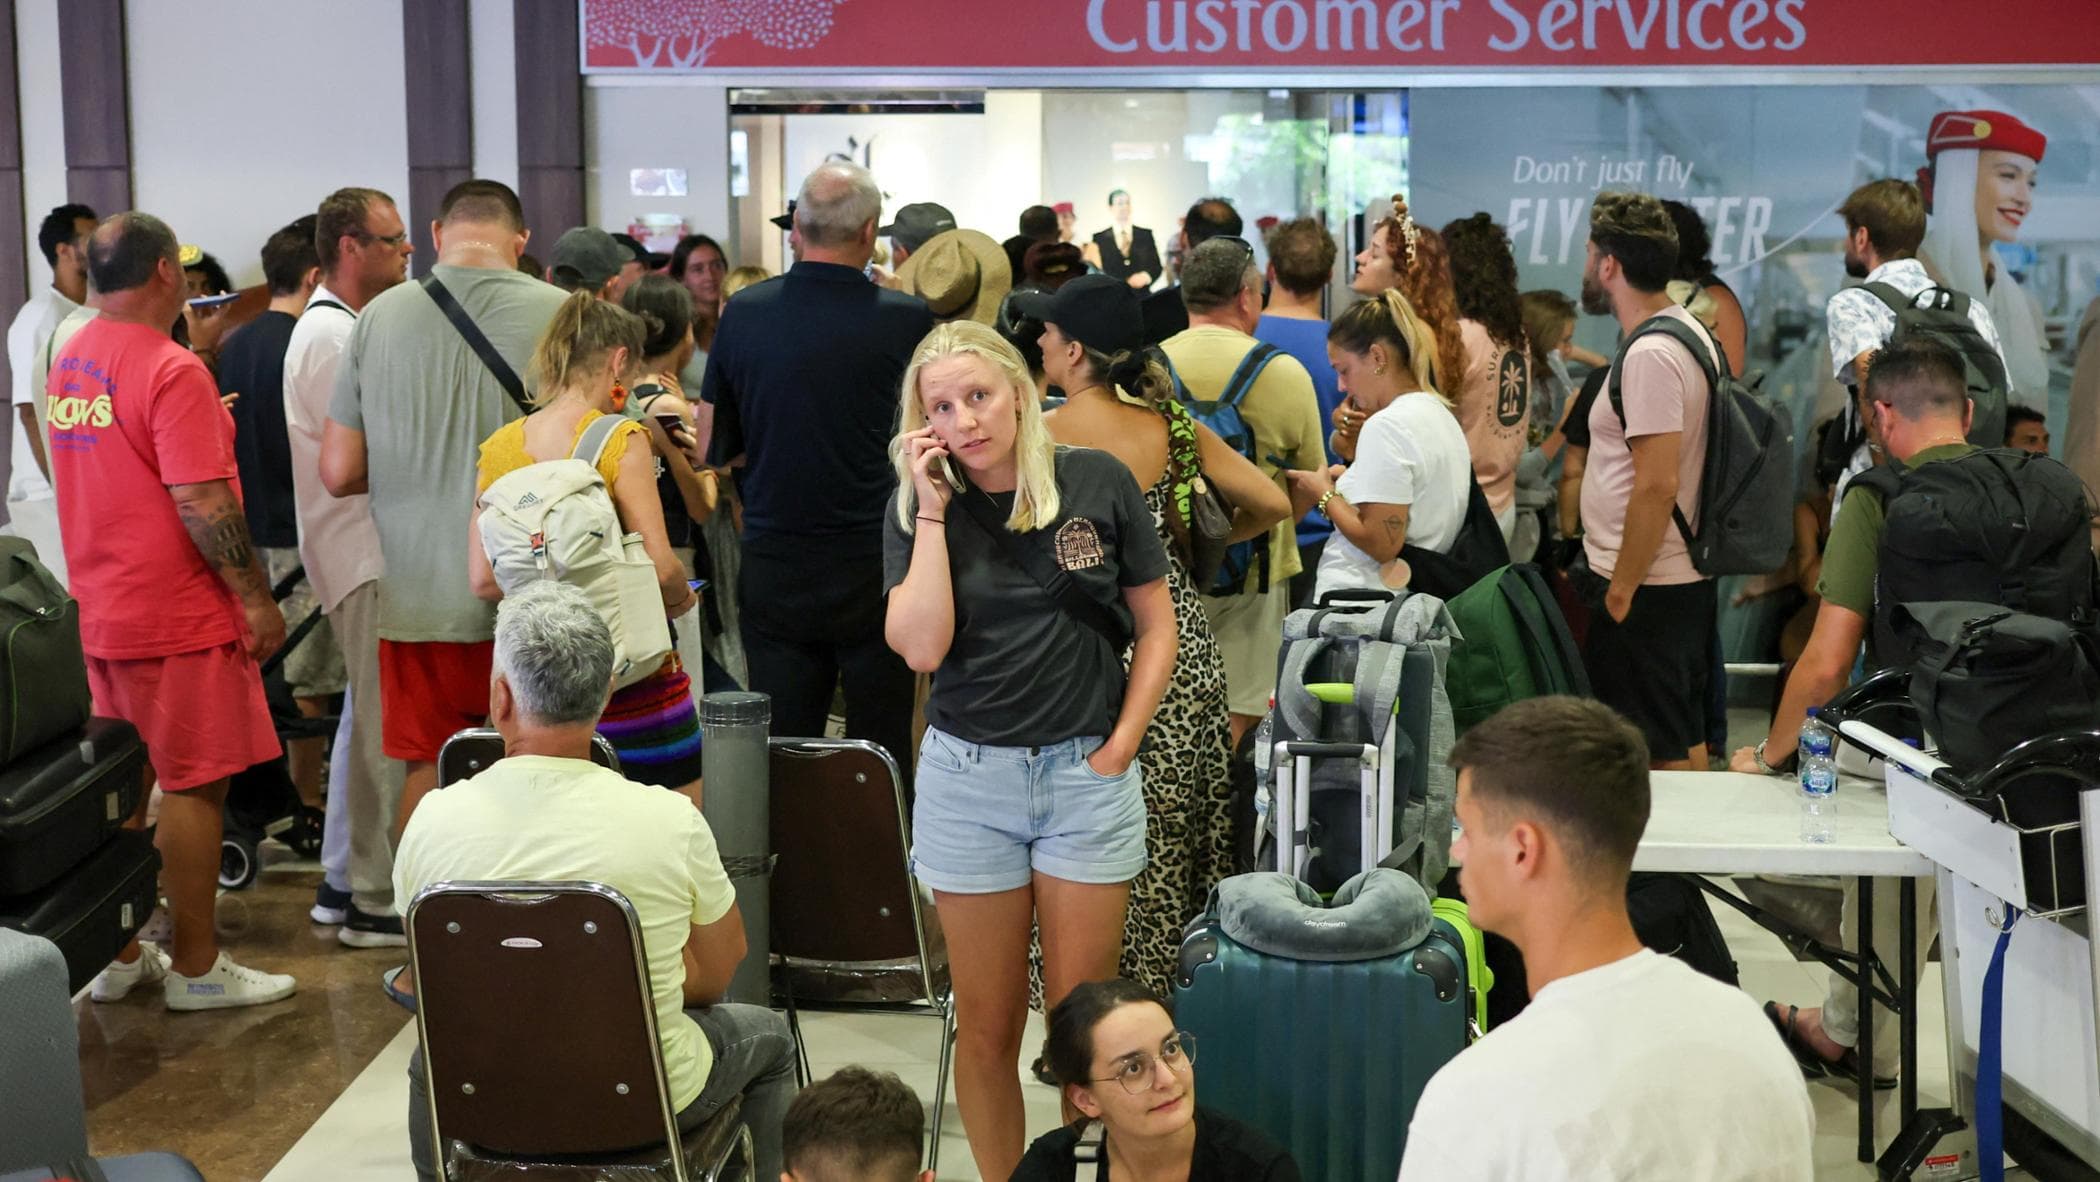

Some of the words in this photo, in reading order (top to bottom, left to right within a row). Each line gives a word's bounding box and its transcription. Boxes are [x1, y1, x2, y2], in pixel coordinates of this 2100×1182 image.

[1085, 0, 1460, 53] Customer
[1486, 0, 1808, 51] Services
[1513, 155, 1588, 185] Don't
[1590, 155, 1647, 191] just
[1656, 154, 1695, 190] fly
[1507, 197, 1585, 265] FLY
